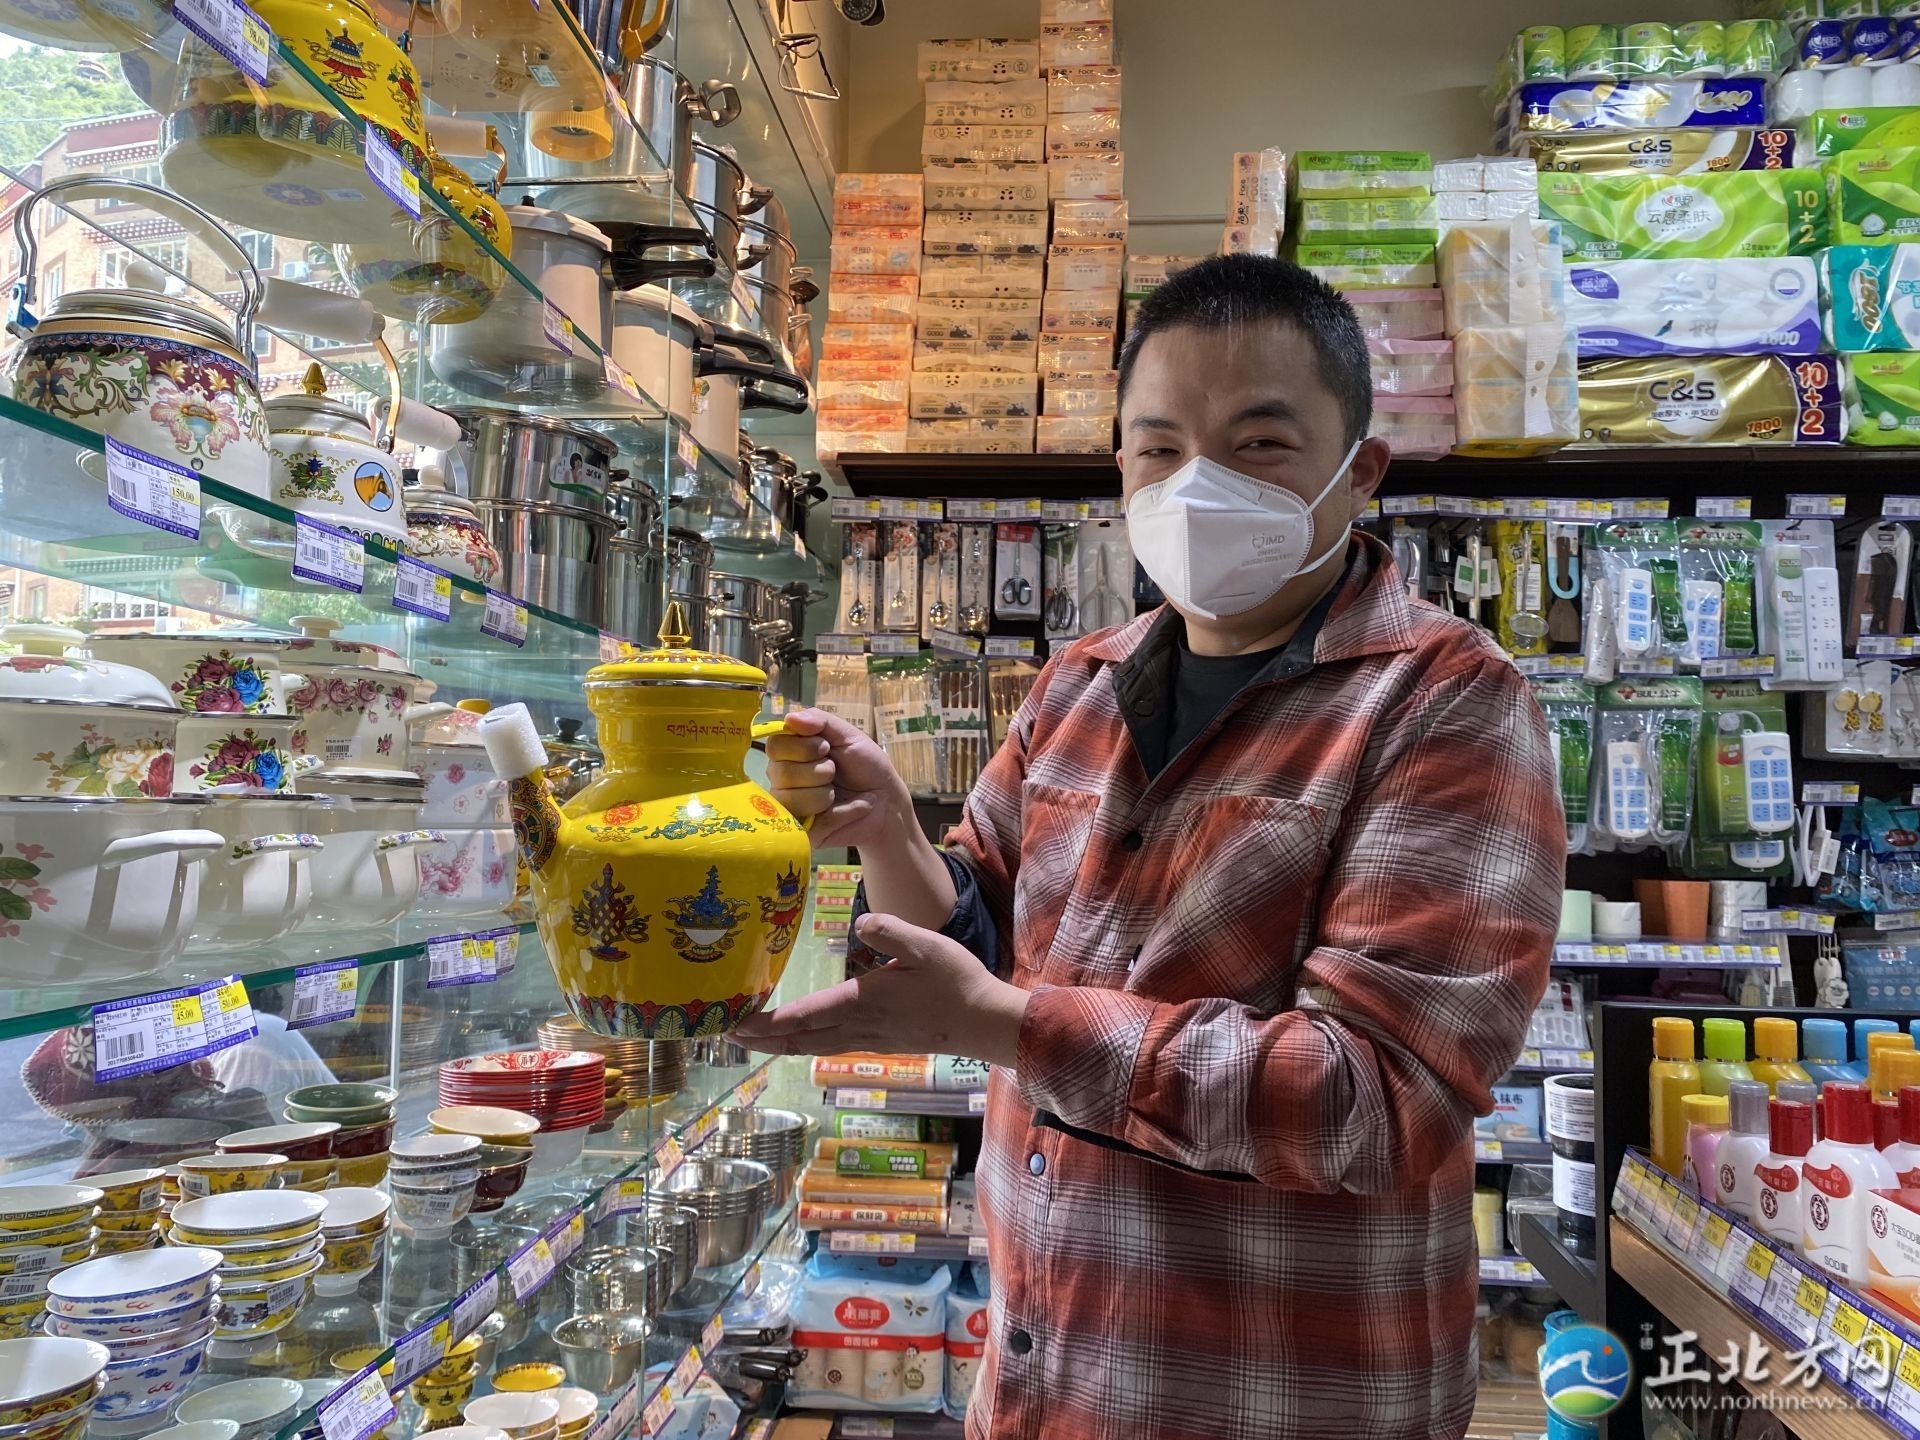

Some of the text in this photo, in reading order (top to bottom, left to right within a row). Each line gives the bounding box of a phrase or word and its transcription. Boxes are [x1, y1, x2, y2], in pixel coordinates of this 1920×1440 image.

[1628, 138, 1672, 153] C&S
[1757, 131, 1788, 147] 10
[1793, 189, 1819, 208] 10
[1648, 208, 1712, 225] 云感柔肤
[1798, 224, 1816, 245] 2
[1796, 361, 1829, 390] 10
[1649, 378, 1716, 401] C&S
[1746, 416, 1783, 433] 1800
[1800, 407, 1825, 436] 2
[172, 486, 195, 502] 150.00
[1265, 535, 1286, 546] IMD
[176, 1010, 194, 1022] 45.00
[520, 1053, 537, 1066] 祥
